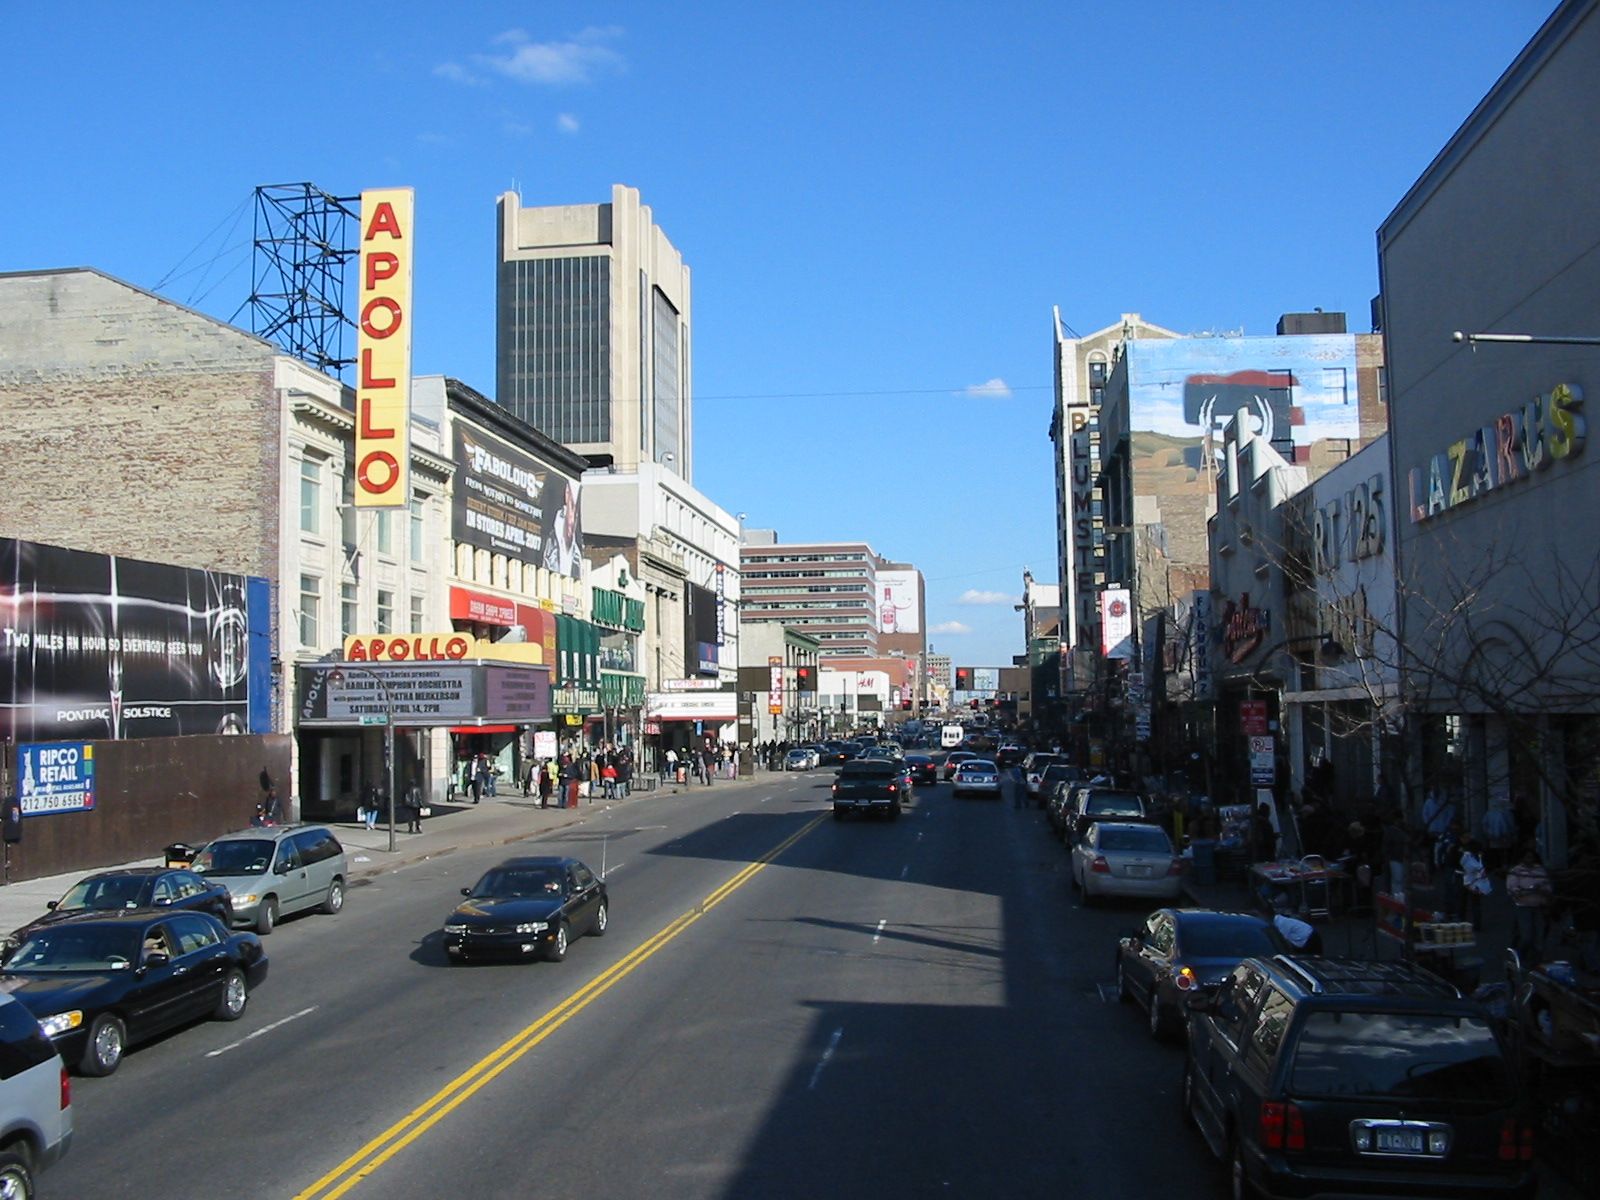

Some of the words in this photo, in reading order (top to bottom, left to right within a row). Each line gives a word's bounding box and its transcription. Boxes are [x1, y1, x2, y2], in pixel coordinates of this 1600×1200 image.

[358, 202, 402, 494] APOLLO
[471, 445, 539, 499] FABOLOUS
[1071, 412, 1095, 648] BLUMSTEIN
[33, 633, 64, 650] MILES
[82, 635, 107, 651] HOUR
[108, 637, 121, 652] SO
[123, 637, 166, 654] EVERYBODY
[167, 641, 187, 656] SEES
[347, 636, 468, 662] APOLLO
[345, 681, 375, 690] HARLEM
[418, 680, 463, 689] ORCHESTRA
[57, 708, 110, 721] PONTIAC
[123, 707, 171, 718] SOLSTICE
[40, 748, 79, 765] RIPCO
[40, 765, 78, 783] RETAIL
